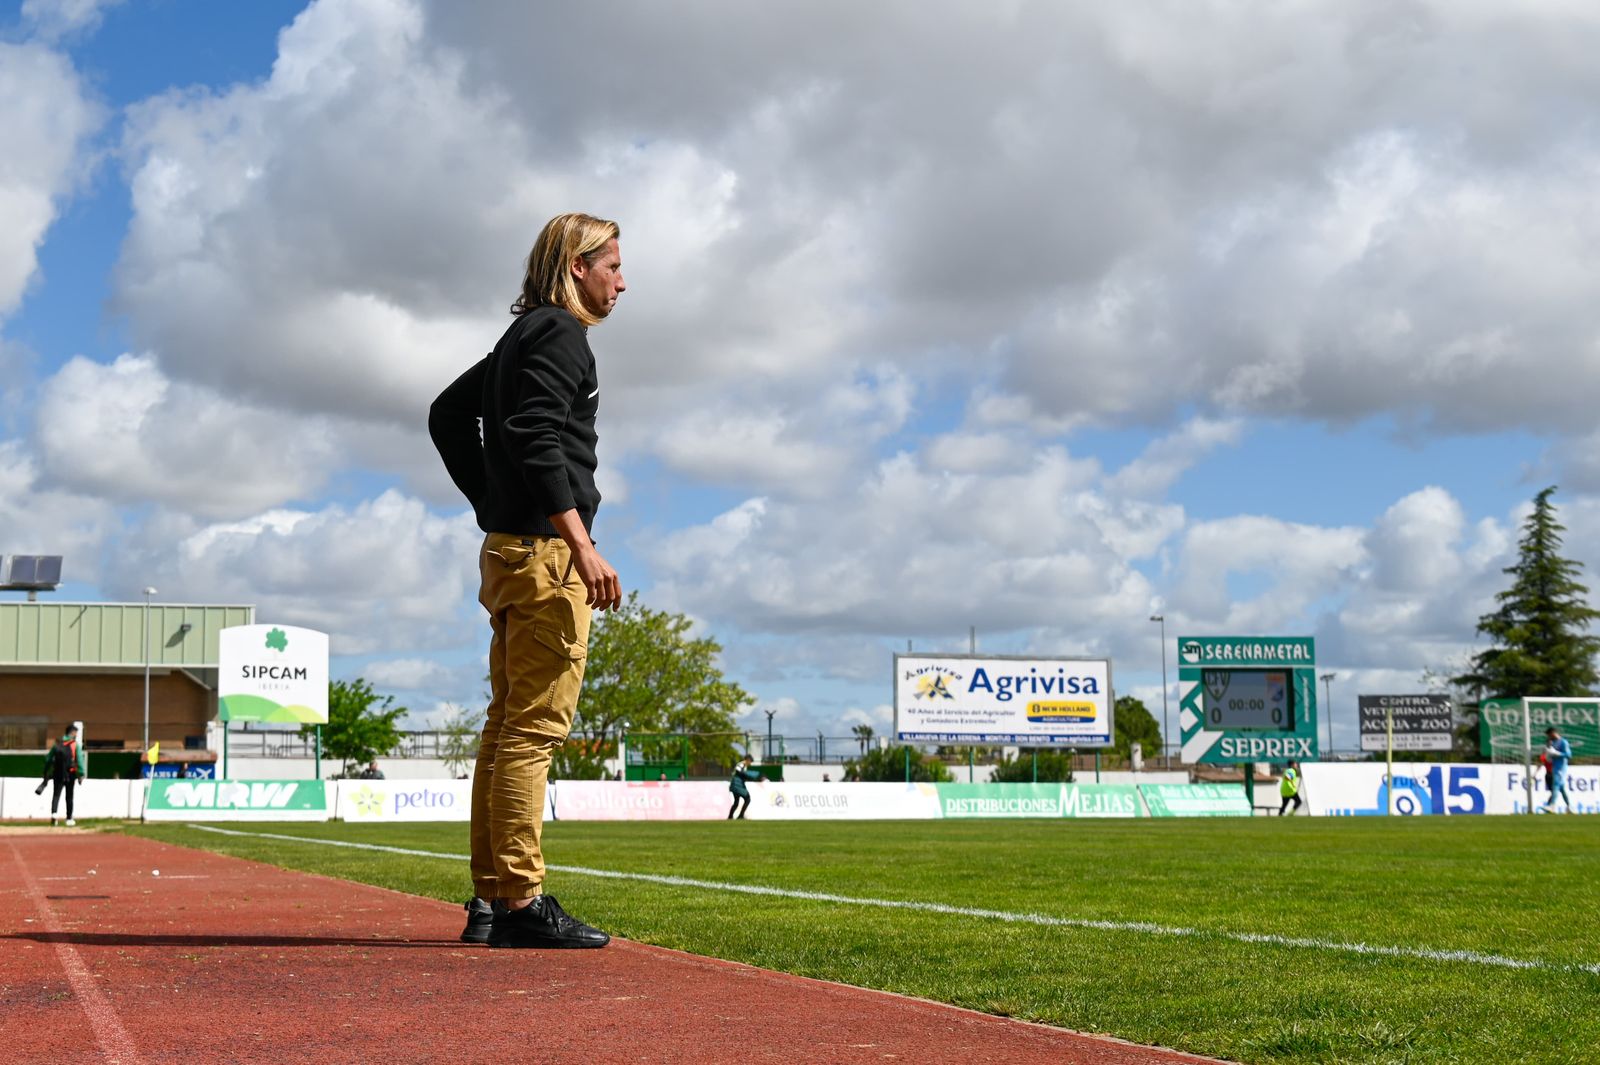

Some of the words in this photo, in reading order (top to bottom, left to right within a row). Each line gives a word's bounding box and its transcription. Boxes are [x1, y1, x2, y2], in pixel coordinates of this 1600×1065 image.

[1205, 643, 1311, 660] SERENAMETAL
[241, 664, 307, 680] SIPCAM
[968, 667, 1100, 702] Agrivisa
[1228, 698, 1265, 711] 00:00
[1484, 701, 1596, 726] Goadex
[1211, 707, 1222, 724] 0
[1271, 707, 1282, 725] 0
[1421, 718, 1450, 729] ZOO
[1220, 737, 1313, 757] SEPREX
[166, 783, 298, 808] MRW
[1426, 766, 1485, 815] 15
[945, 798, 1057, 813] DISTRIBUCIONES
[1059, 783, 1135, 817] MEJIAS
